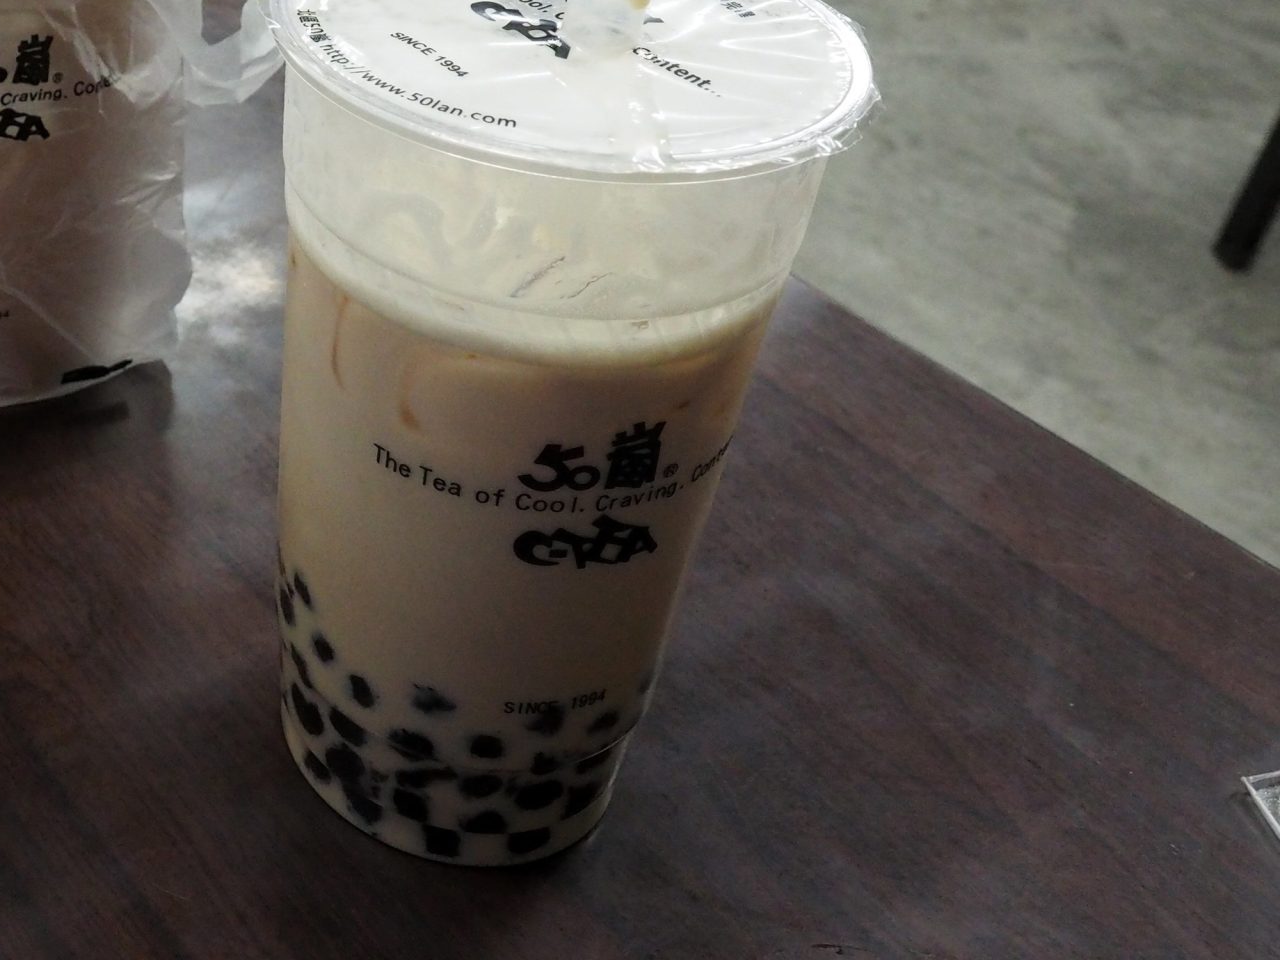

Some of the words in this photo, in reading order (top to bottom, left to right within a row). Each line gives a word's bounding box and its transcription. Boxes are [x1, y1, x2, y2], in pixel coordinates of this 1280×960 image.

[390, 31, 436, 56] SINCE
[434, 56, 469, 78] 1994
[0, 87, 68, 108] Craving.
[319, 43, 517, 128] http://www.50lan.com
[373, 443, 412, 478] The
[419, 466, 462, 497] Tea
[475, 489, 504, 508] of
[595, 477, 685, 513] Craving.
[571, 688, 607, 710] 1994
